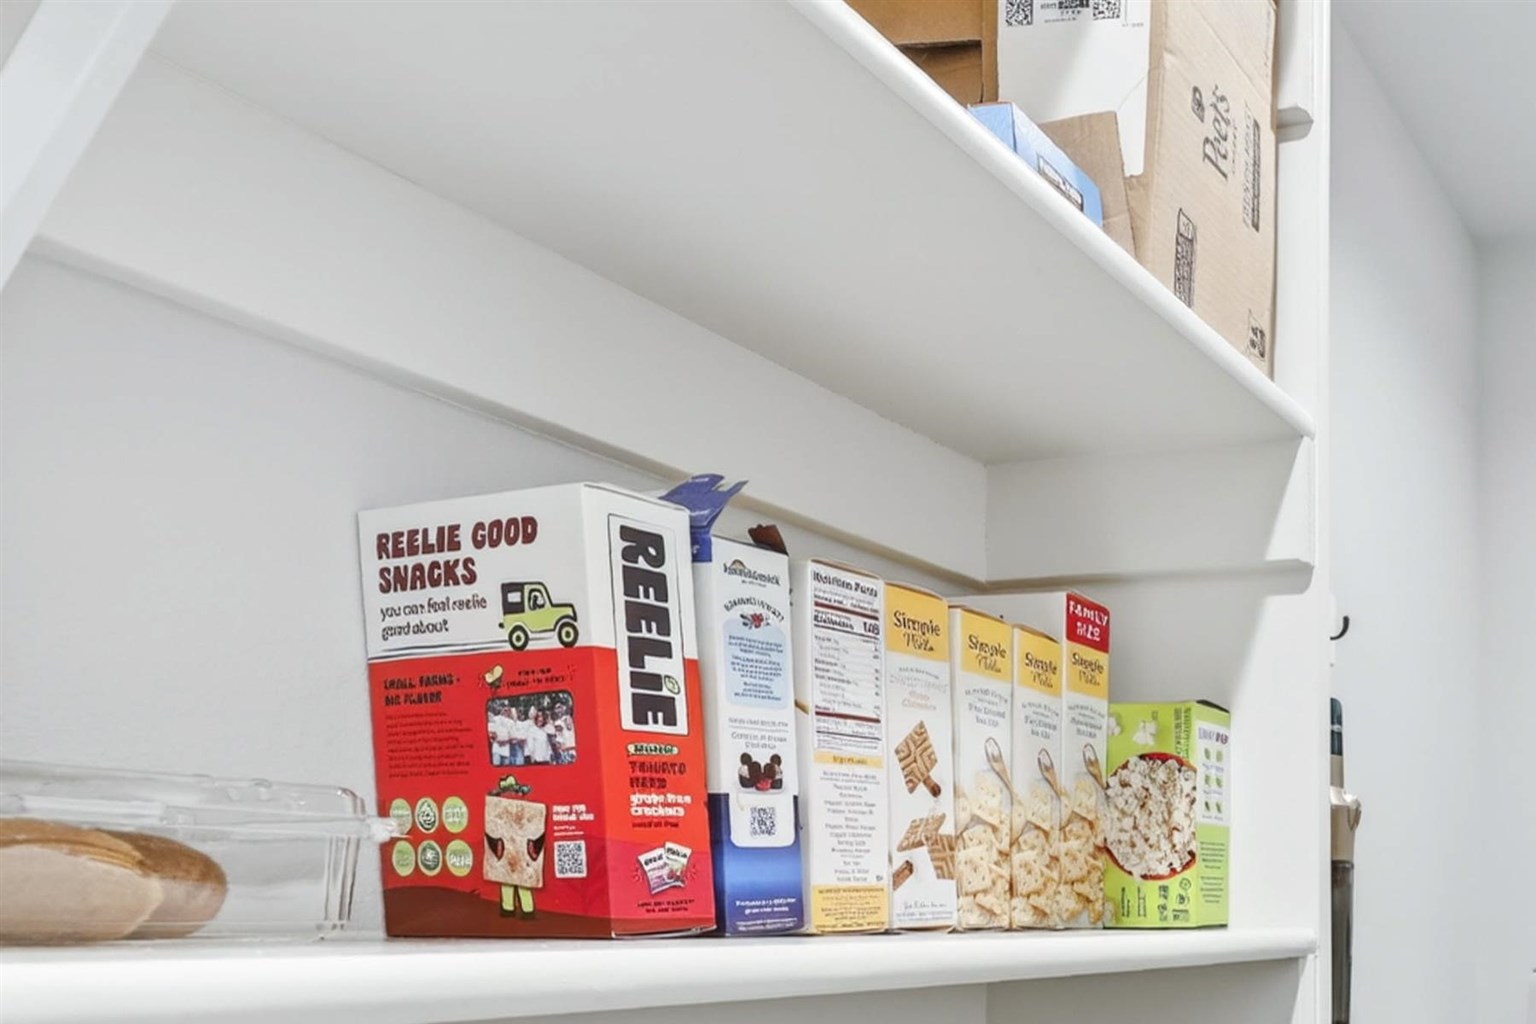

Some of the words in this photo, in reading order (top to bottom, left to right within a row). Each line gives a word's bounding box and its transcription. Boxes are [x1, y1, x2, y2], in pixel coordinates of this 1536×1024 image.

[376, 524, 462, 560] REELIE
[471, 516, 538, 550] GOOD
[379, 557, 477, 594] SNACKS
[1068, 600, 1108, 626] FAMILY
